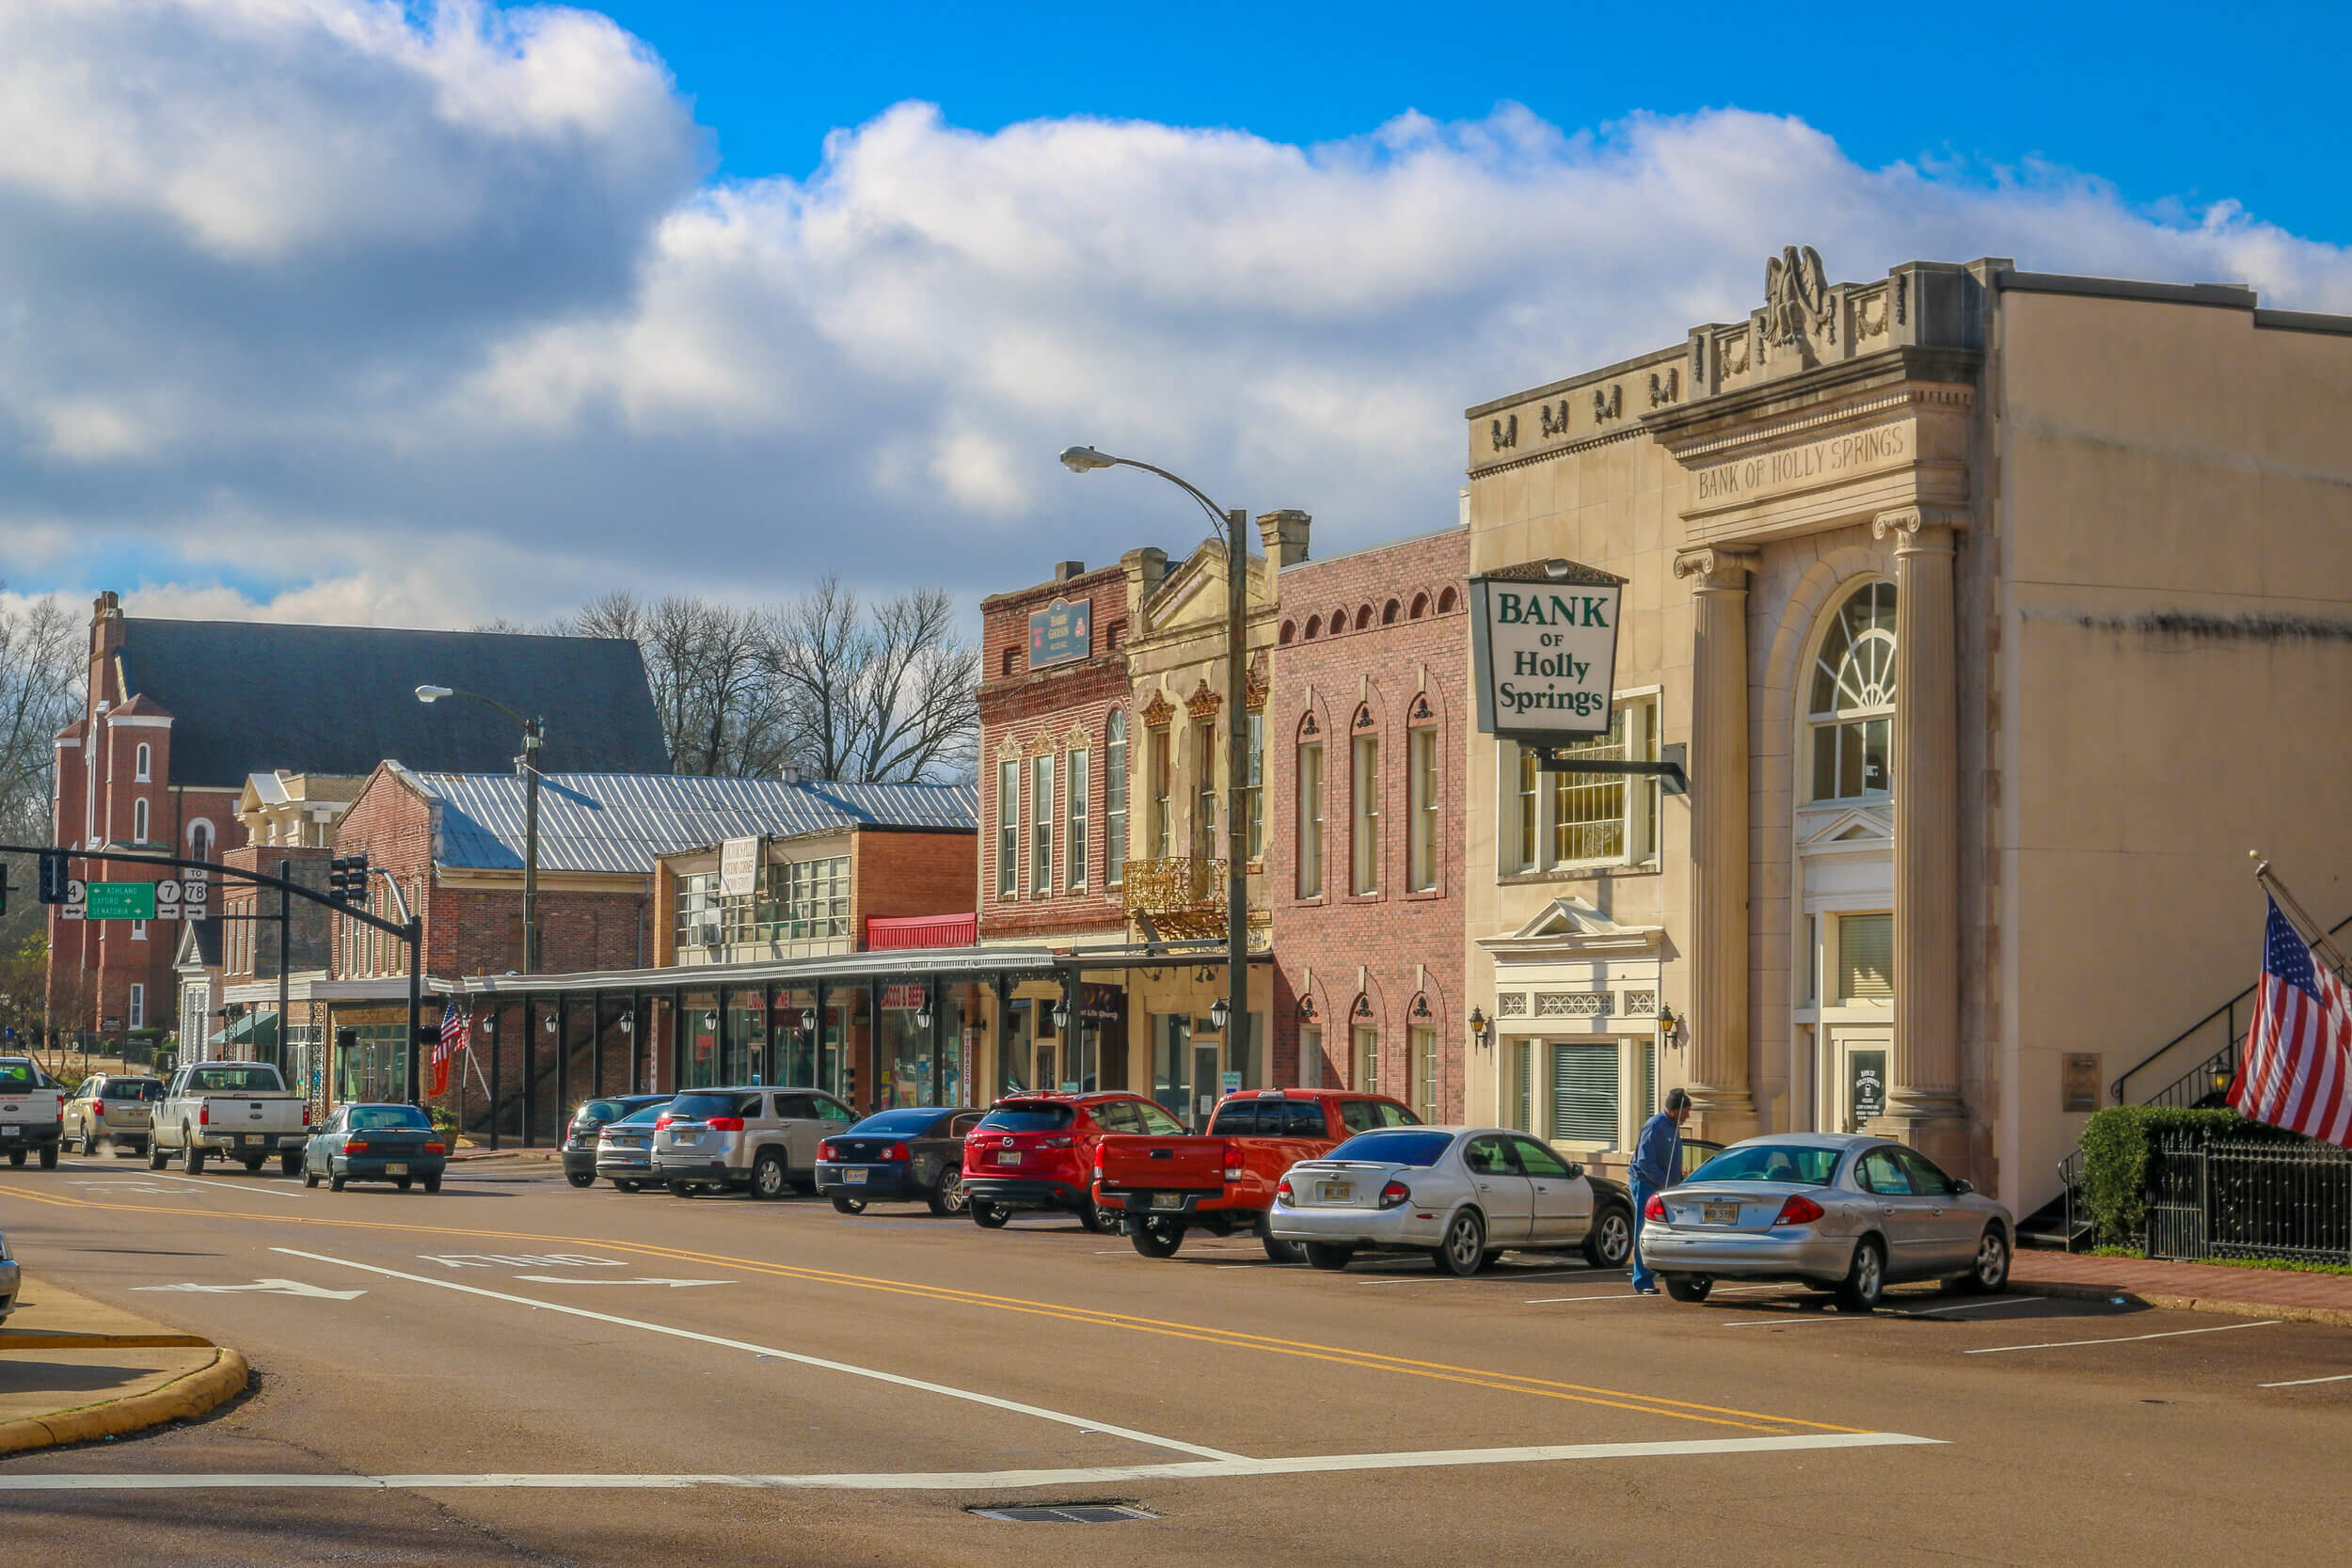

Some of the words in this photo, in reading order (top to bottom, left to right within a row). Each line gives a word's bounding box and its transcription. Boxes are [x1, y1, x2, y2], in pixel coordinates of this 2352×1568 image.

[1699, 464, 1739, 499] BANK
[1745, 459, 1765, 488] OF
[1772, 447, 1824, 483] HOLLY
[1832, 426, 1903, 468] SPRINGS
[1498, 594, 1610, 627] BANK
[1540, 633, 1565, 647] OF
[1514, 651, 1591, 685] Holly
[1500, 682, 1603, 717] Springs
[68, 885, 77, 897] 4
[165, 885, 173, 897] 7
[188, 886, 204, 898] 78
